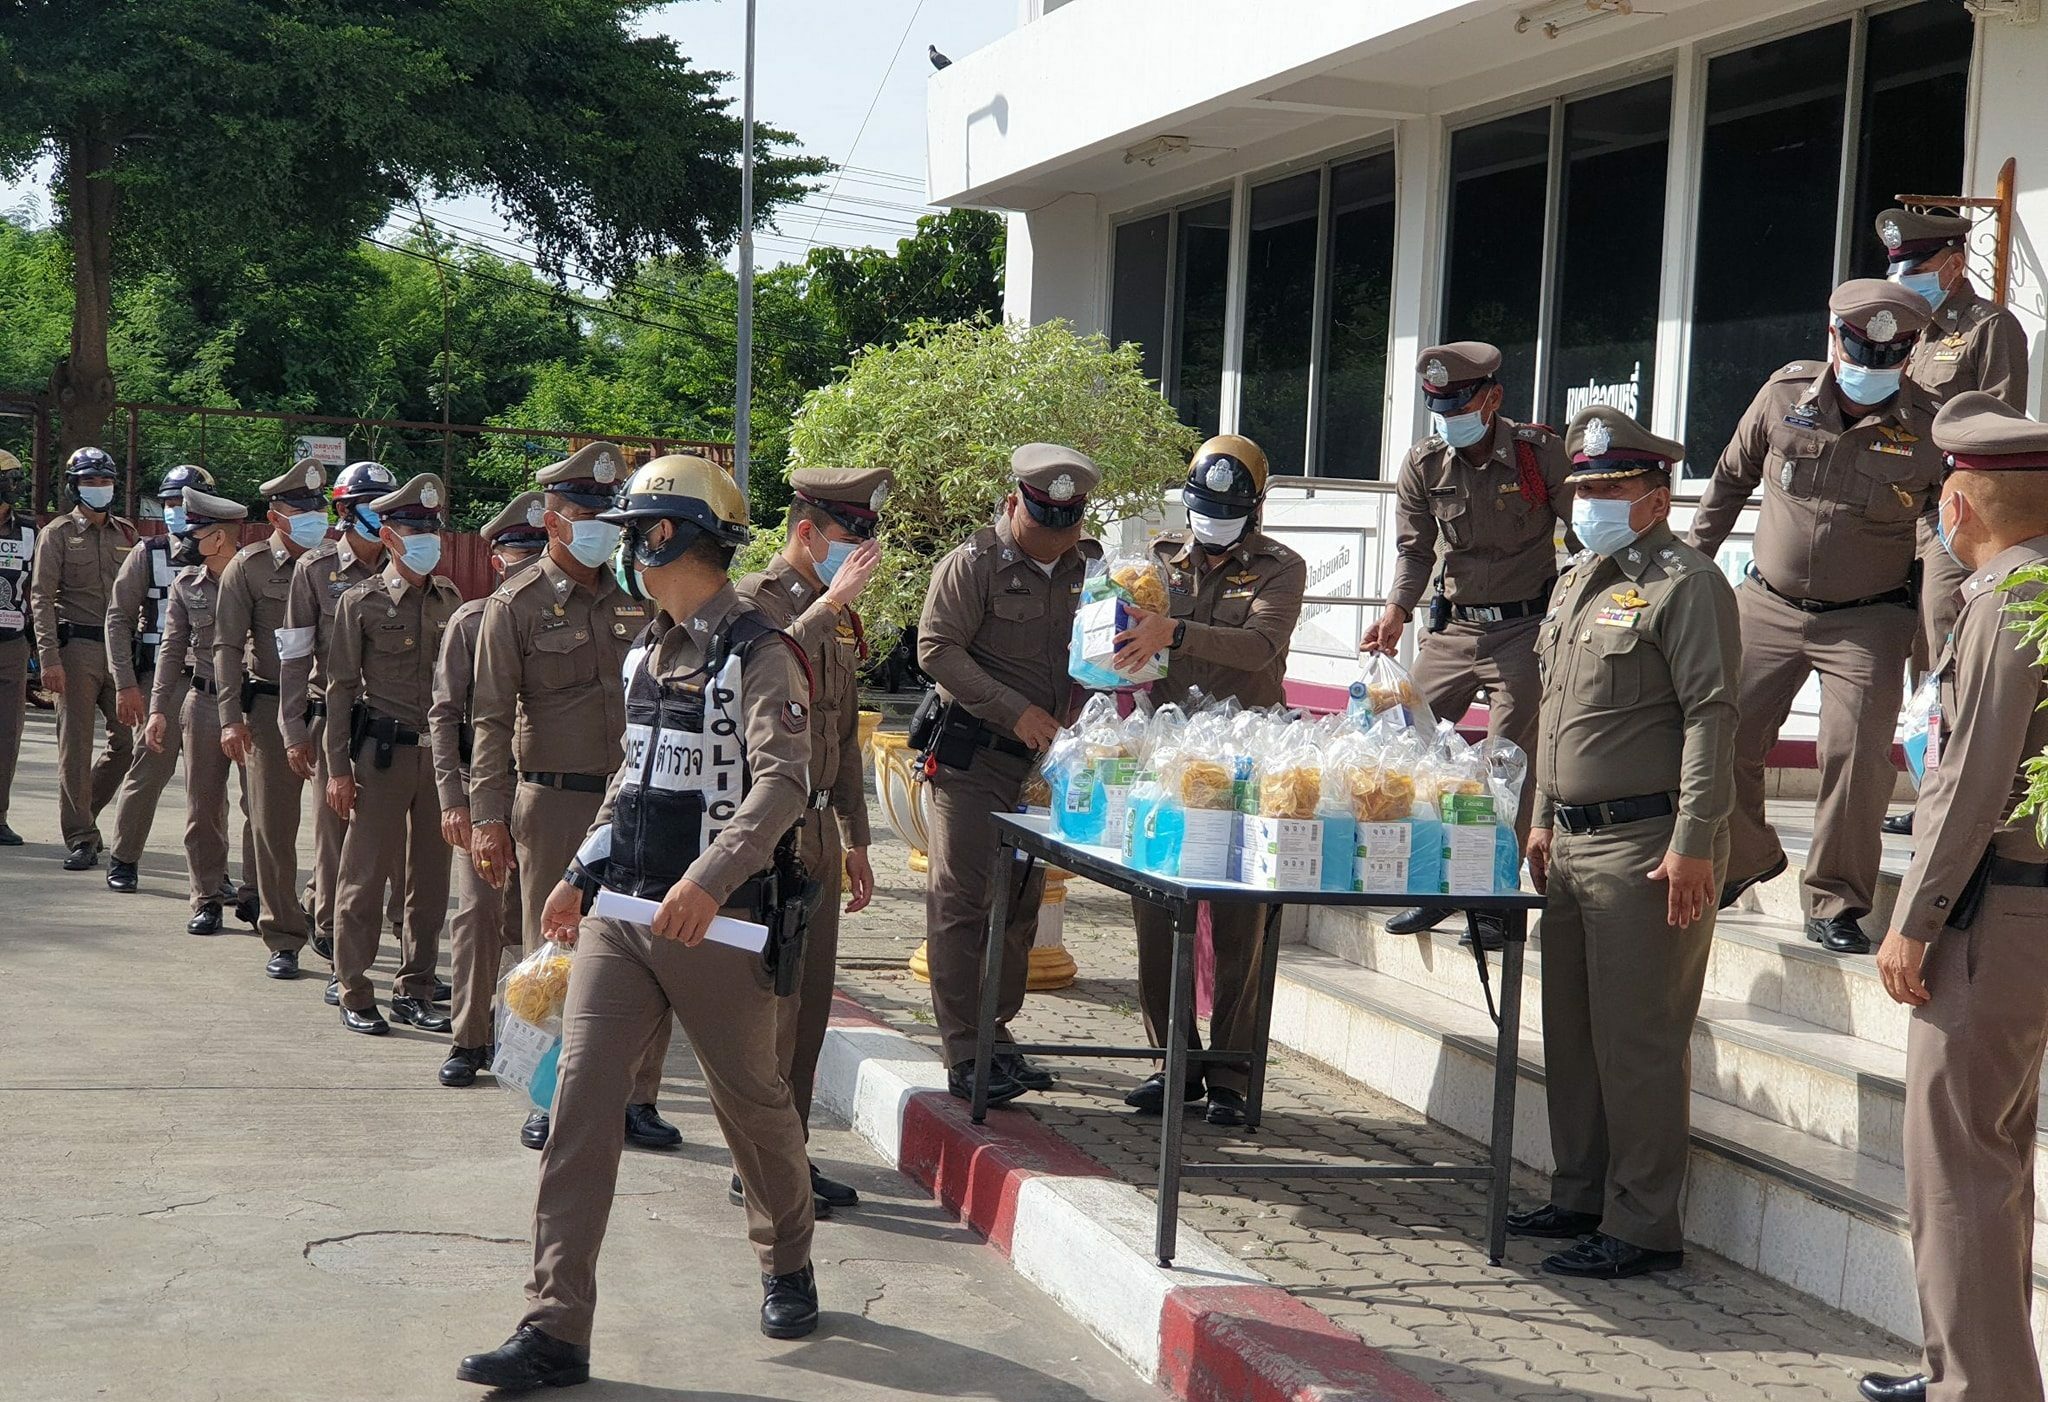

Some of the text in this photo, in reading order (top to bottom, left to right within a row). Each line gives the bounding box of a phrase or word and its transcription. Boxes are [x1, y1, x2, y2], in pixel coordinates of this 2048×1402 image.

[645, 478, 675, 491] 121
[0, 542, 18, 553] CE
[656, 735, 703, 776] ตำรวจ
